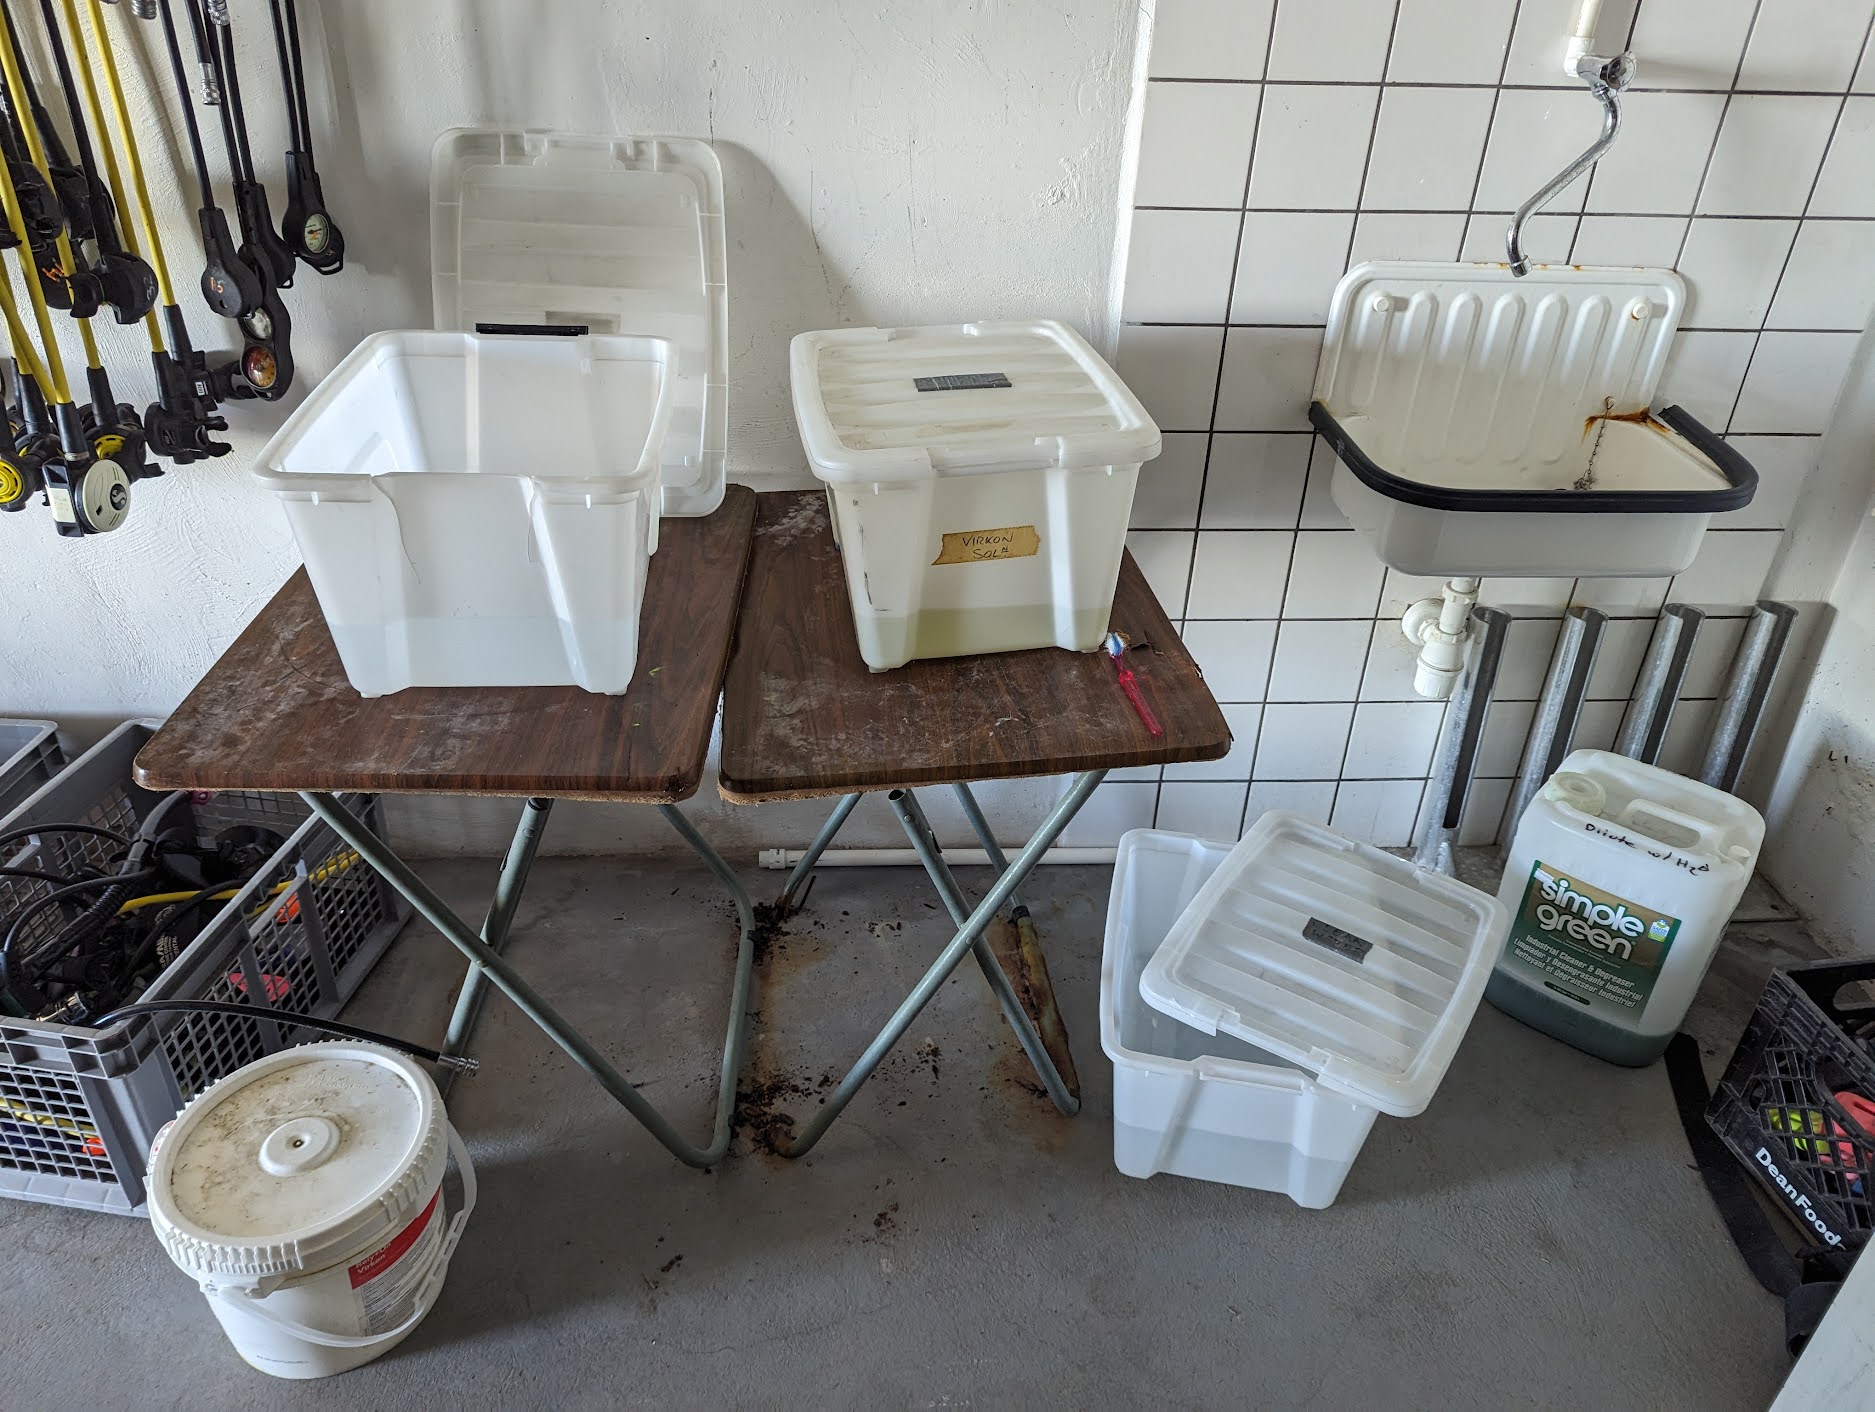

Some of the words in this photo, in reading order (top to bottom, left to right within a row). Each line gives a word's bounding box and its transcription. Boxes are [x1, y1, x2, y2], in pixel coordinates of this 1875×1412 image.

[963, 532, 1014, 547] VIRKON
[1536, 904, 1632, 960] green
[1541, 880, 1645, 937] simple
[1513, 937, 1549, 960] Limpiador
[1551, 957, 1605, 988] Desengrasante
[1604, 981, 1644, 1001] Industrial
[1514, 947, 1546, 969] Nettoyant
[1598, 988, 1637, 1008] Industriel
[1526, 934, 1560, 956] Industrial
[1559, 951, 1591, 970] Cleaner
[1594, 967, 1636, 988] Degreaser
[356, 1252, 388, 1274] Virkon
